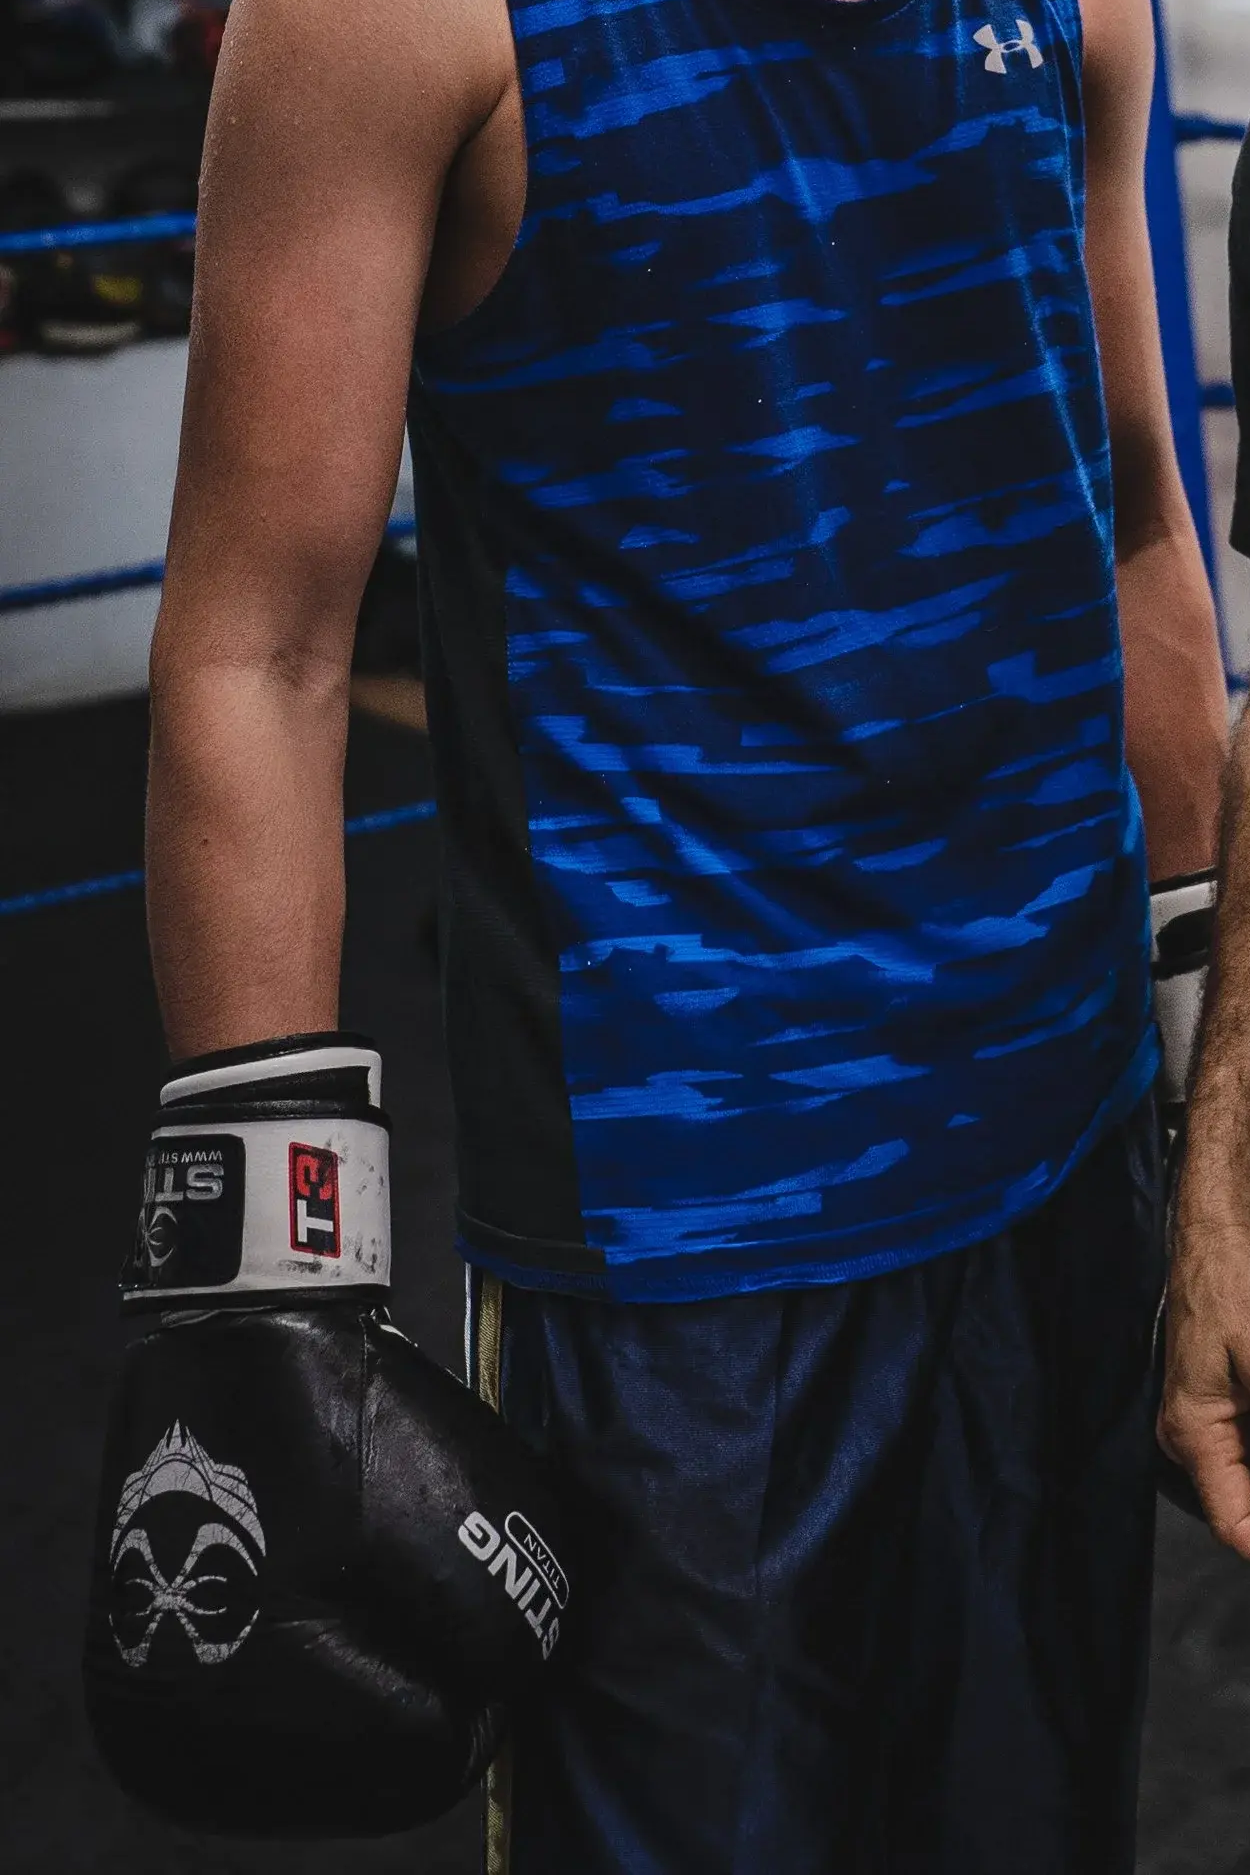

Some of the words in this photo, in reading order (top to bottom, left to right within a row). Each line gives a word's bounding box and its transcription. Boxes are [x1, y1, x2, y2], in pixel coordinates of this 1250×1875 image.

[144, 1164, 224, 1203] STI
[296, 1154, 334, 1243] T3
[457, 1510, 560, 1661] STING
[523, 1533, 562, 1589] TITAN
